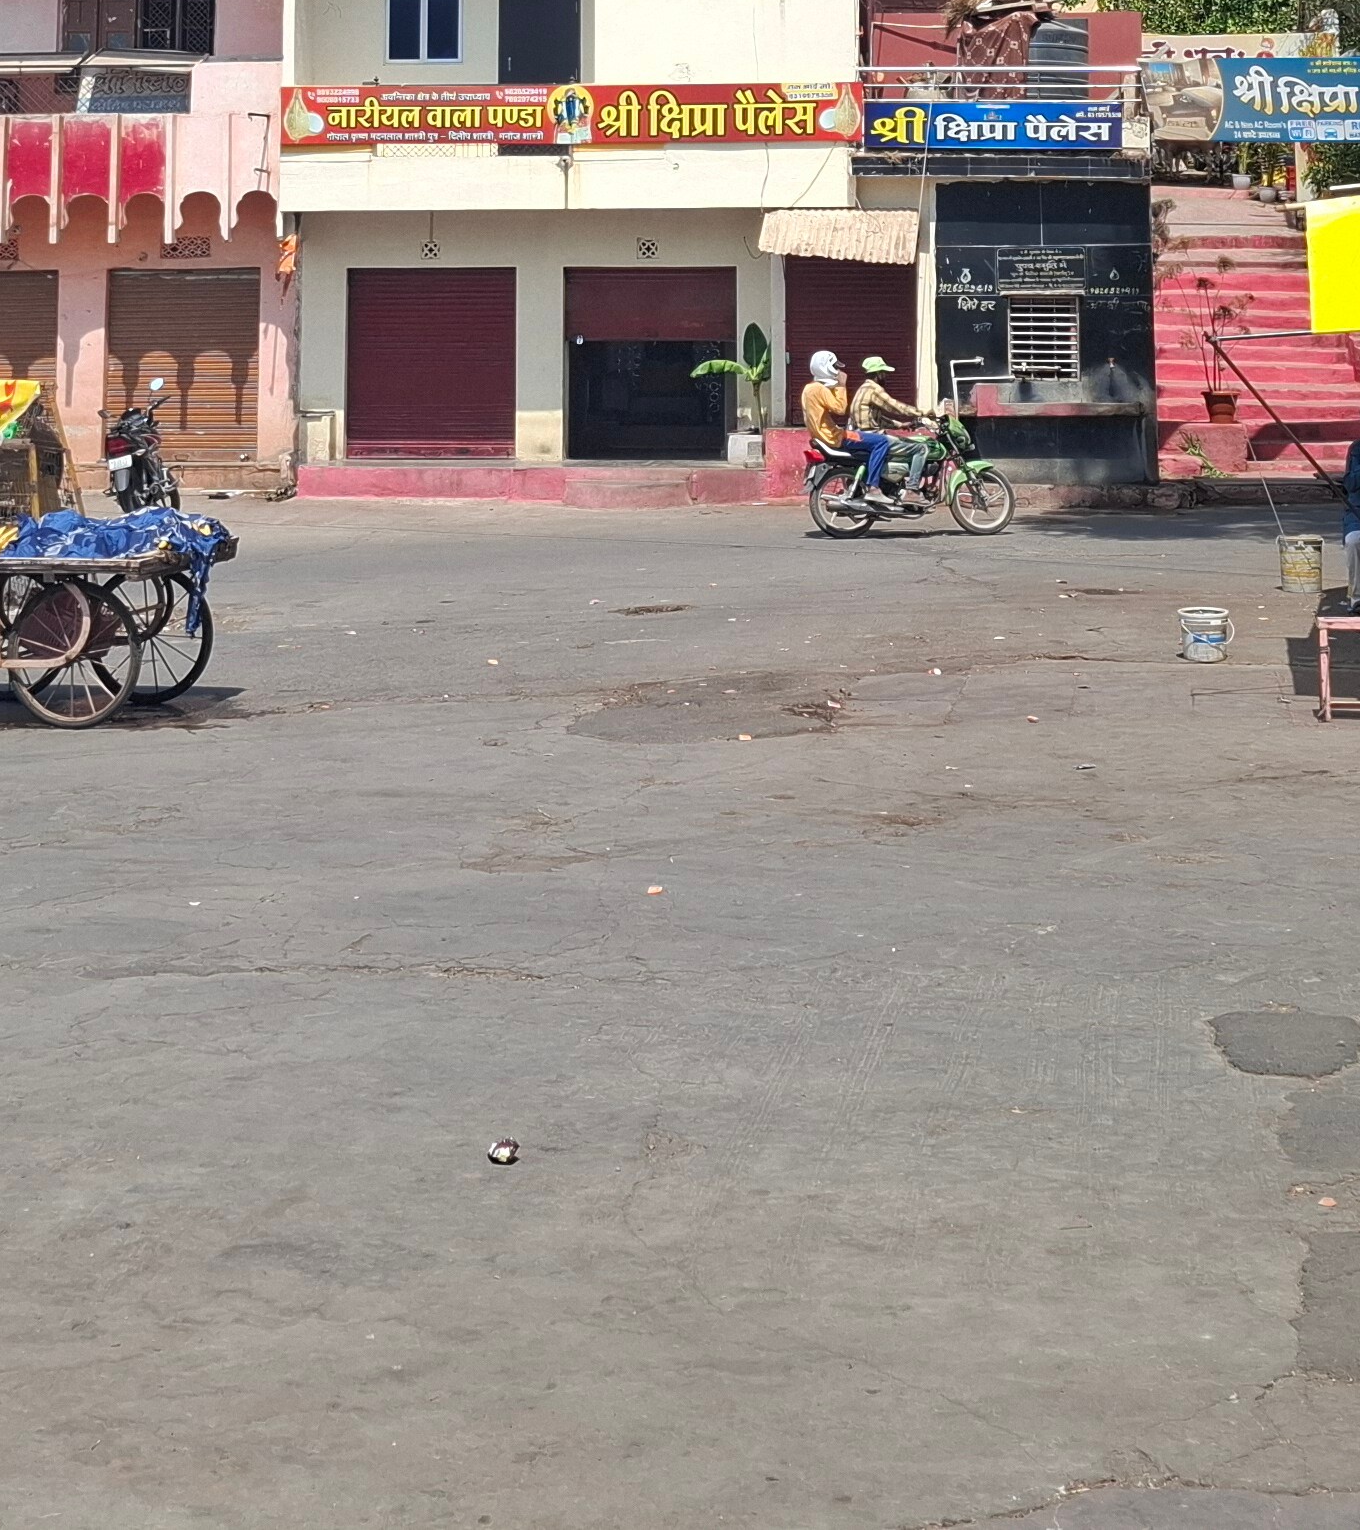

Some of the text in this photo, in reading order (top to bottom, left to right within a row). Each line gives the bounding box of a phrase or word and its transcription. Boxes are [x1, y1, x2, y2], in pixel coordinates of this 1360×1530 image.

[326, 96, 544, 129] नारीयल वाला पण्डा
[597, 88, 817, 139] श्री क्षिप्रा पैलेस
[1233, 65, 1275, 115] श्री
[1276, 76, 1359, 118] क्षिप्रा
[871, 106, 1112, 144] श्री क्षिप्रा पैलेस
